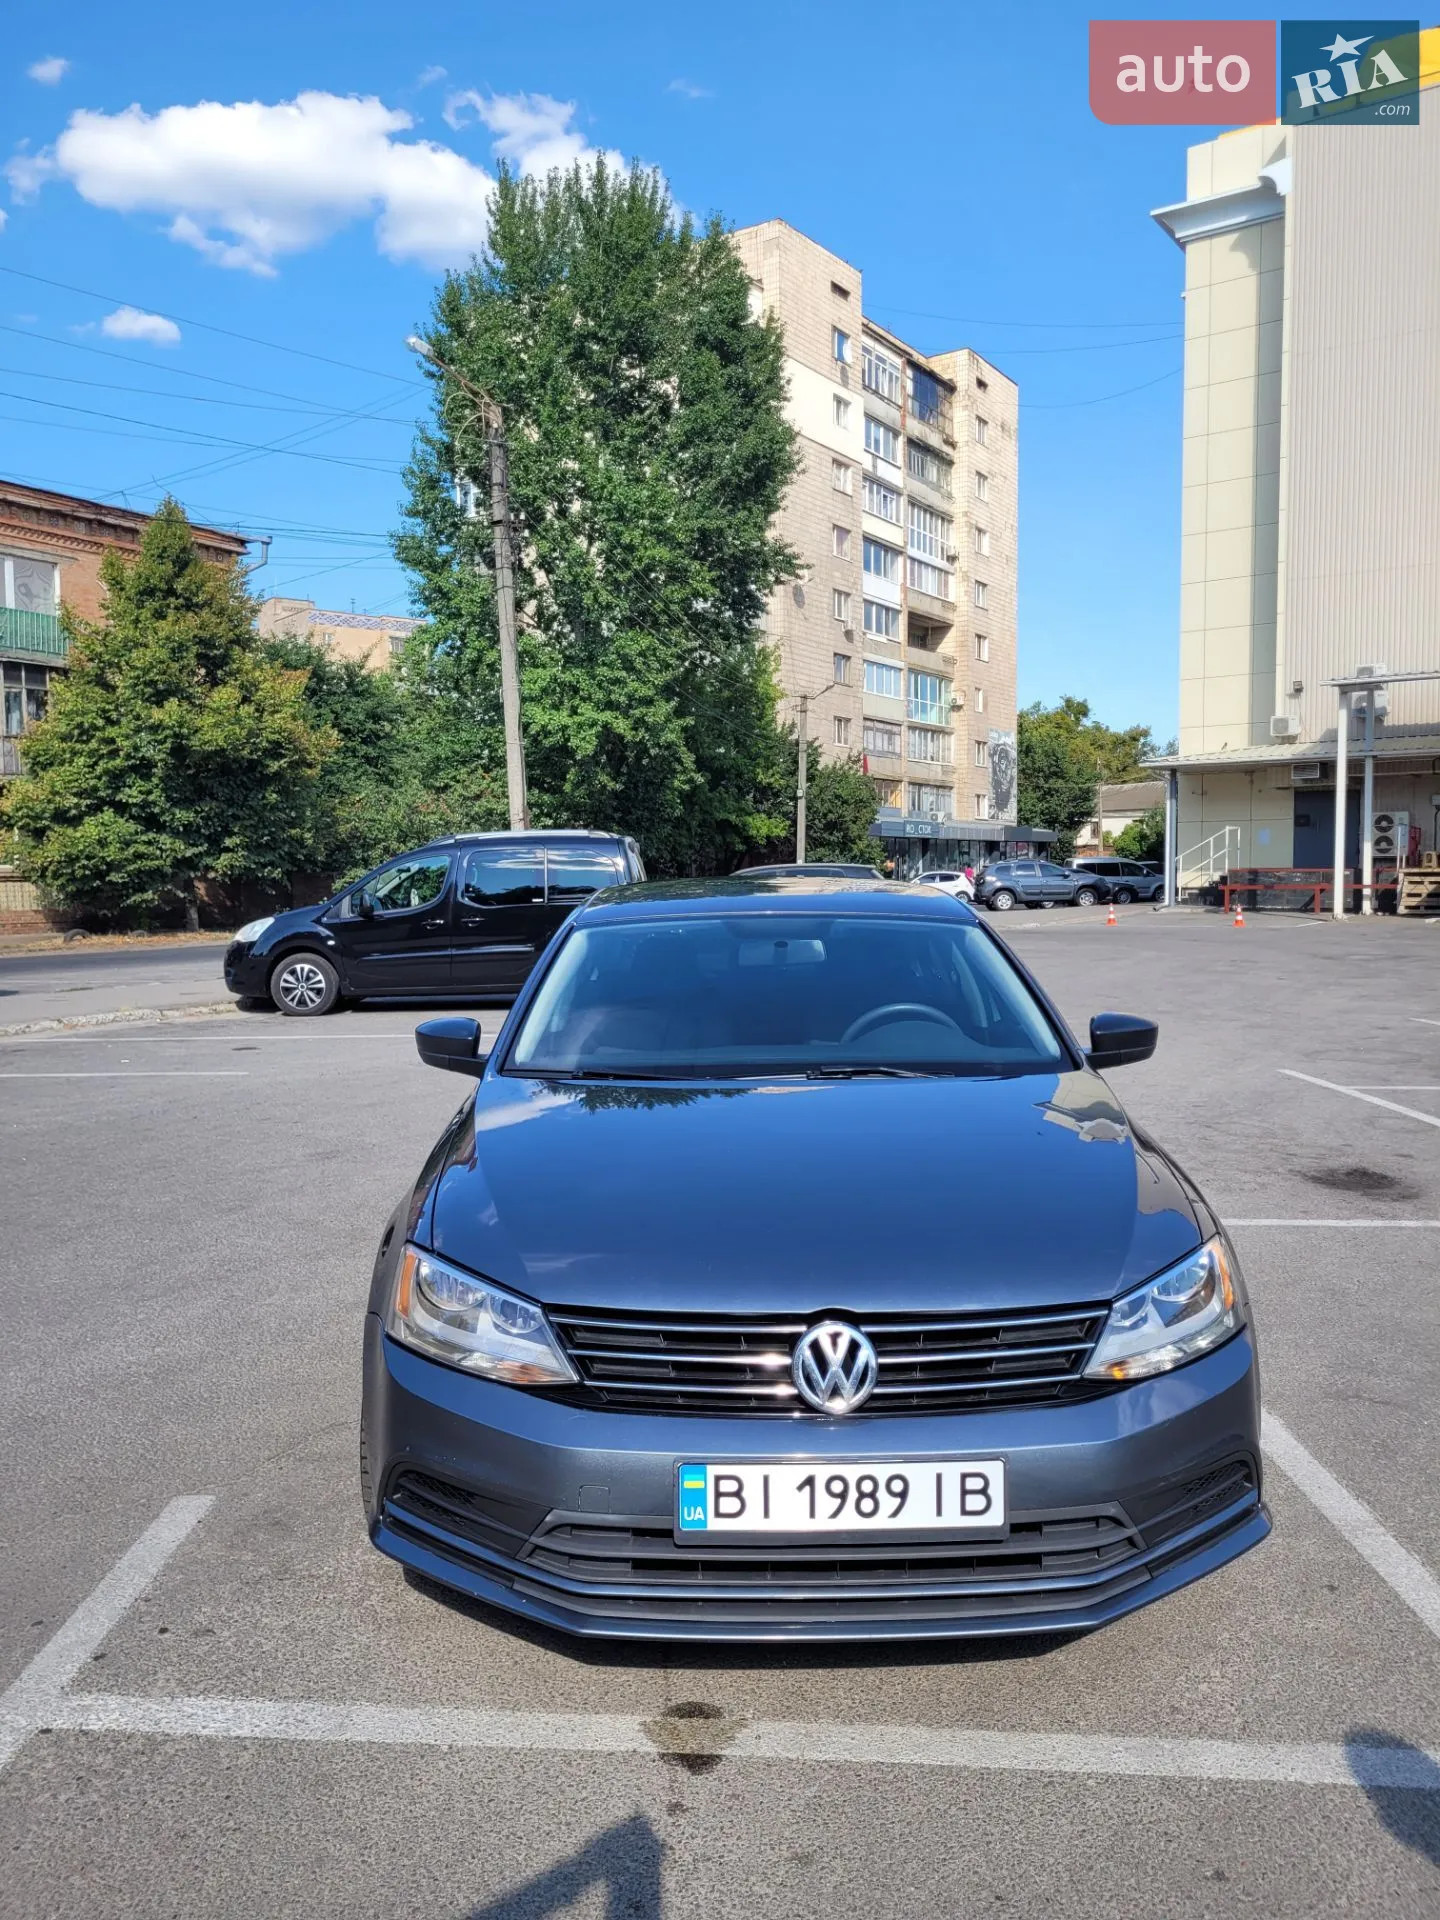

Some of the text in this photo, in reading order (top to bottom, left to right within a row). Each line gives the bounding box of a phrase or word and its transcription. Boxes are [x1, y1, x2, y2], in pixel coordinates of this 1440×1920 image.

[713, 1472, 993, 1519] BI 1989 IB
[683, 1507, 705, 1521] UA
